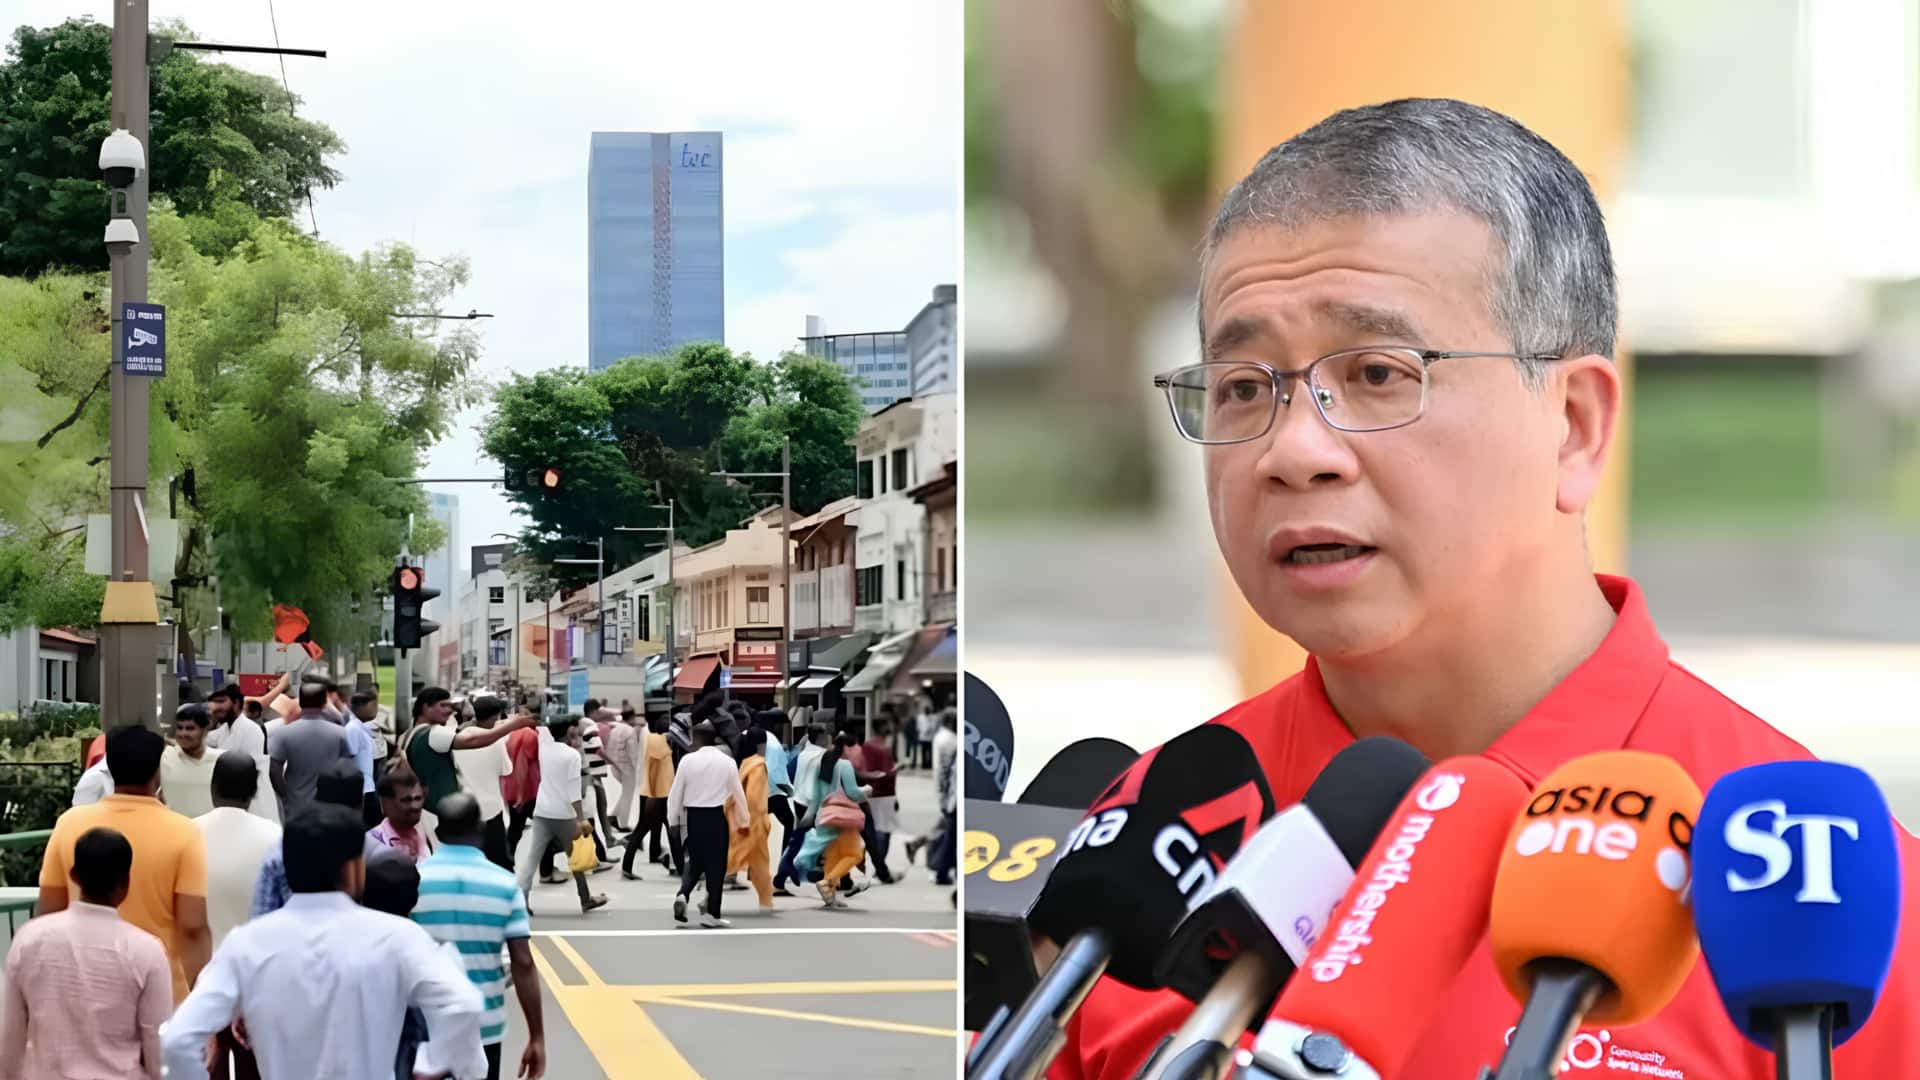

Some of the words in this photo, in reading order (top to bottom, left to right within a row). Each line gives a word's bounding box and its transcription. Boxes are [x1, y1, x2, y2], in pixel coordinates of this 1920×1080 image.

[1527, 786, 1655, 821] asia
[1057, 808, 1129, 863] na
[1516, 819, 1637, 860] one
[1724, 800, 1859, 903] ST
[1153, 823, 1217, 911] cn
[1312, 815, 1434, 982] mothership
[1610, 1045, 1665, 1066] Community
